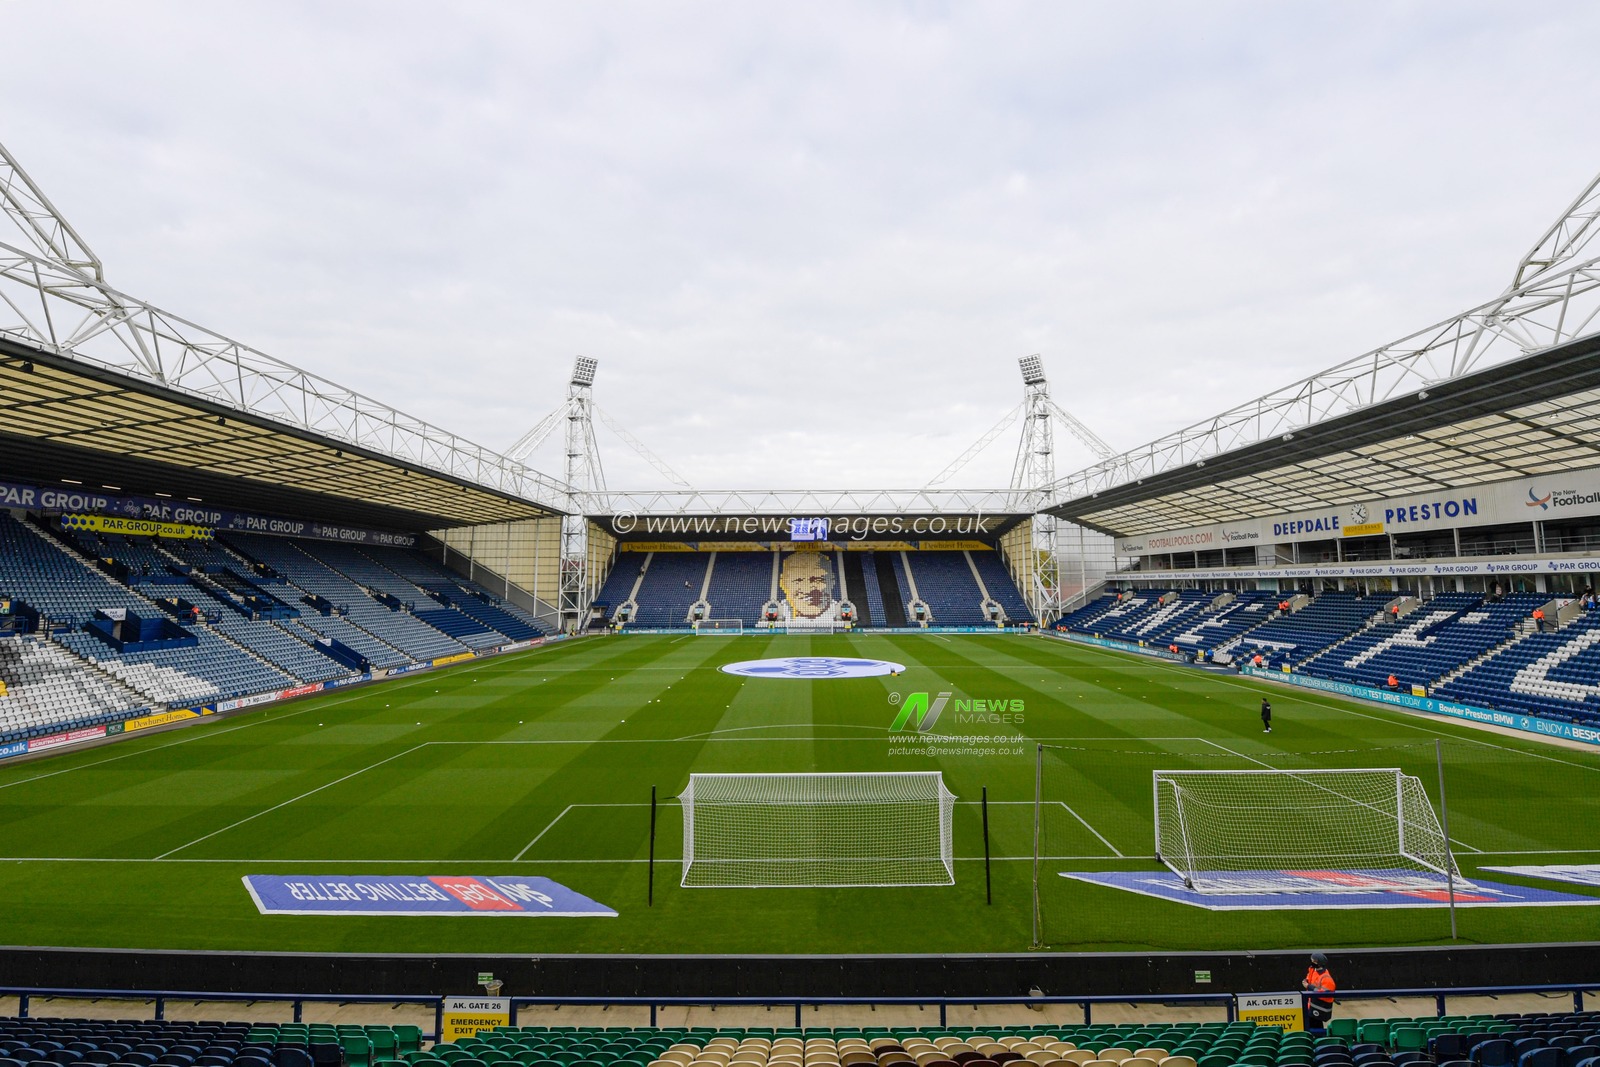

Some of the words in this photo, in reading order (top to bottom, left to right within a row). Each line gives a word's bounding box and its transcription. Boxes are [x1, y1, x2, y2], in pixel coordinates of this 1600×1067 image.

[41, 491, 107, 511] GROUP
[1553, 492, 1600, 507] Football
[175, 507, 222, 524] GROUP
[1385, 498, 1477, 524] PRESTON
[102, 518, 186, 536] PAR-GROUP.co.uk
[246, 517, 267, 530] PAR
[270, 520, 304, 534] GROUP
[322, 526, 338, 538] PAR
[339, 529, 367, 542] GROUP
[1274, 516, 1339, 536] DEEPDALE
[380, 534, 393, 544] PAR
[393, 535, 415, 547] GROUP
[1149, 532, 1213, 549] FOOTBALLPOOLS.COM
[1338, 684, 1352, 695] BOOK
[1353, 686, 1369, 698] YOUR
[1368, 689, 1382, 700] TEST
[1383, 692, 1400, 703] DRIVE
[1401, 695, 1421, 707] TODAY
[133, 714, 164, 729] Dewhurst
[165, 711, 187, 723] Homes
[1438, 703, 1464, 716] Bowker
[1465, 707, 1493, 721] Preston
[1493, 712, 1513, 725] BMW
[1536, 720, 1563, 735] ENJOY
[1564, 727, 1571, 736] A
[284, 882, 360, 901] BETTER
[355, 882, 449, 902] BETTING
[442, 883, 513, 907] bet
[485, 878, 554, 908] sky
[450, 1018, 502, 1026] EMERGENCY
[1246, 1014, 1296, 1022] EMERGENCY
